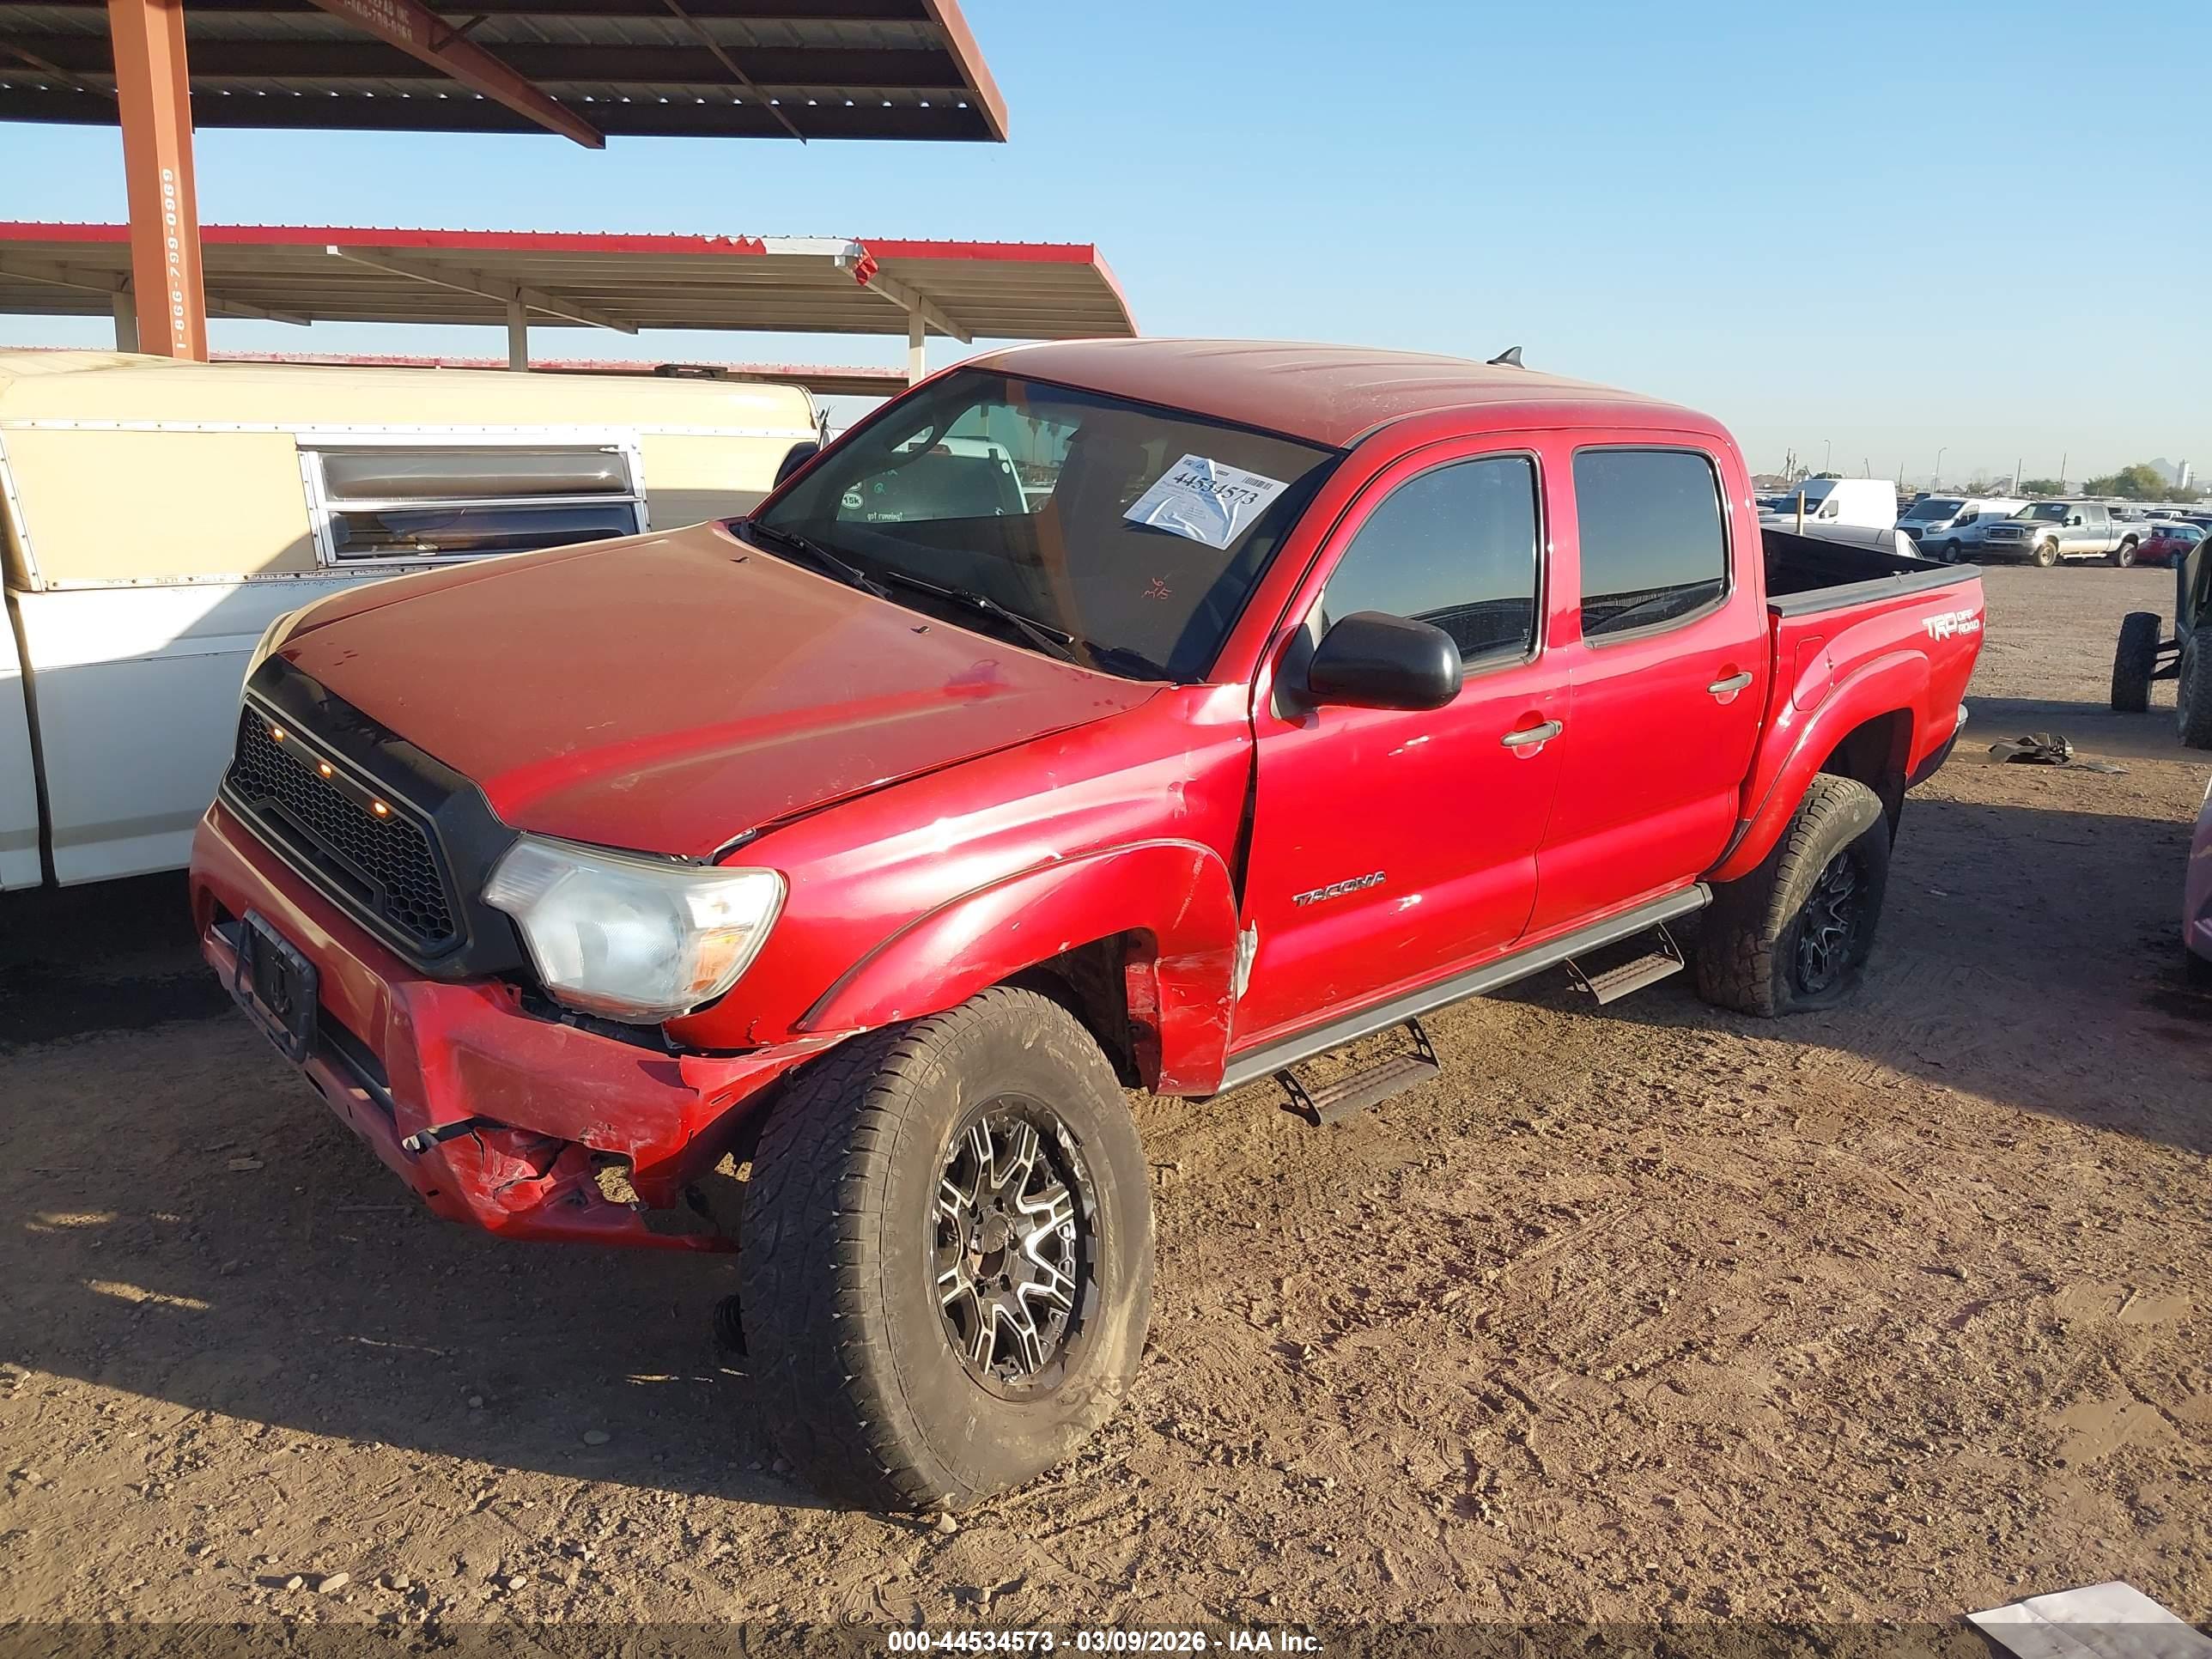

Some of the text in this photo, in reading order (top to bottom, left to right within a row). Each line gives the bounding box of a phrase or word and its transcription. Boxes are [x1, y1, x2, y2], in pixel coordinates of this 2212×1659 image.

[162, 168, 187, 349] 1-866-799-0969
[1173, 471, 1259, 505] 44534573
[1922, 611, 1958, 641] TRD
[1957, 609, 1973, 622] OFF
[1958, 618, 1979, 635] ROAD
[1291, 871, 1386, 906] TACOMA
